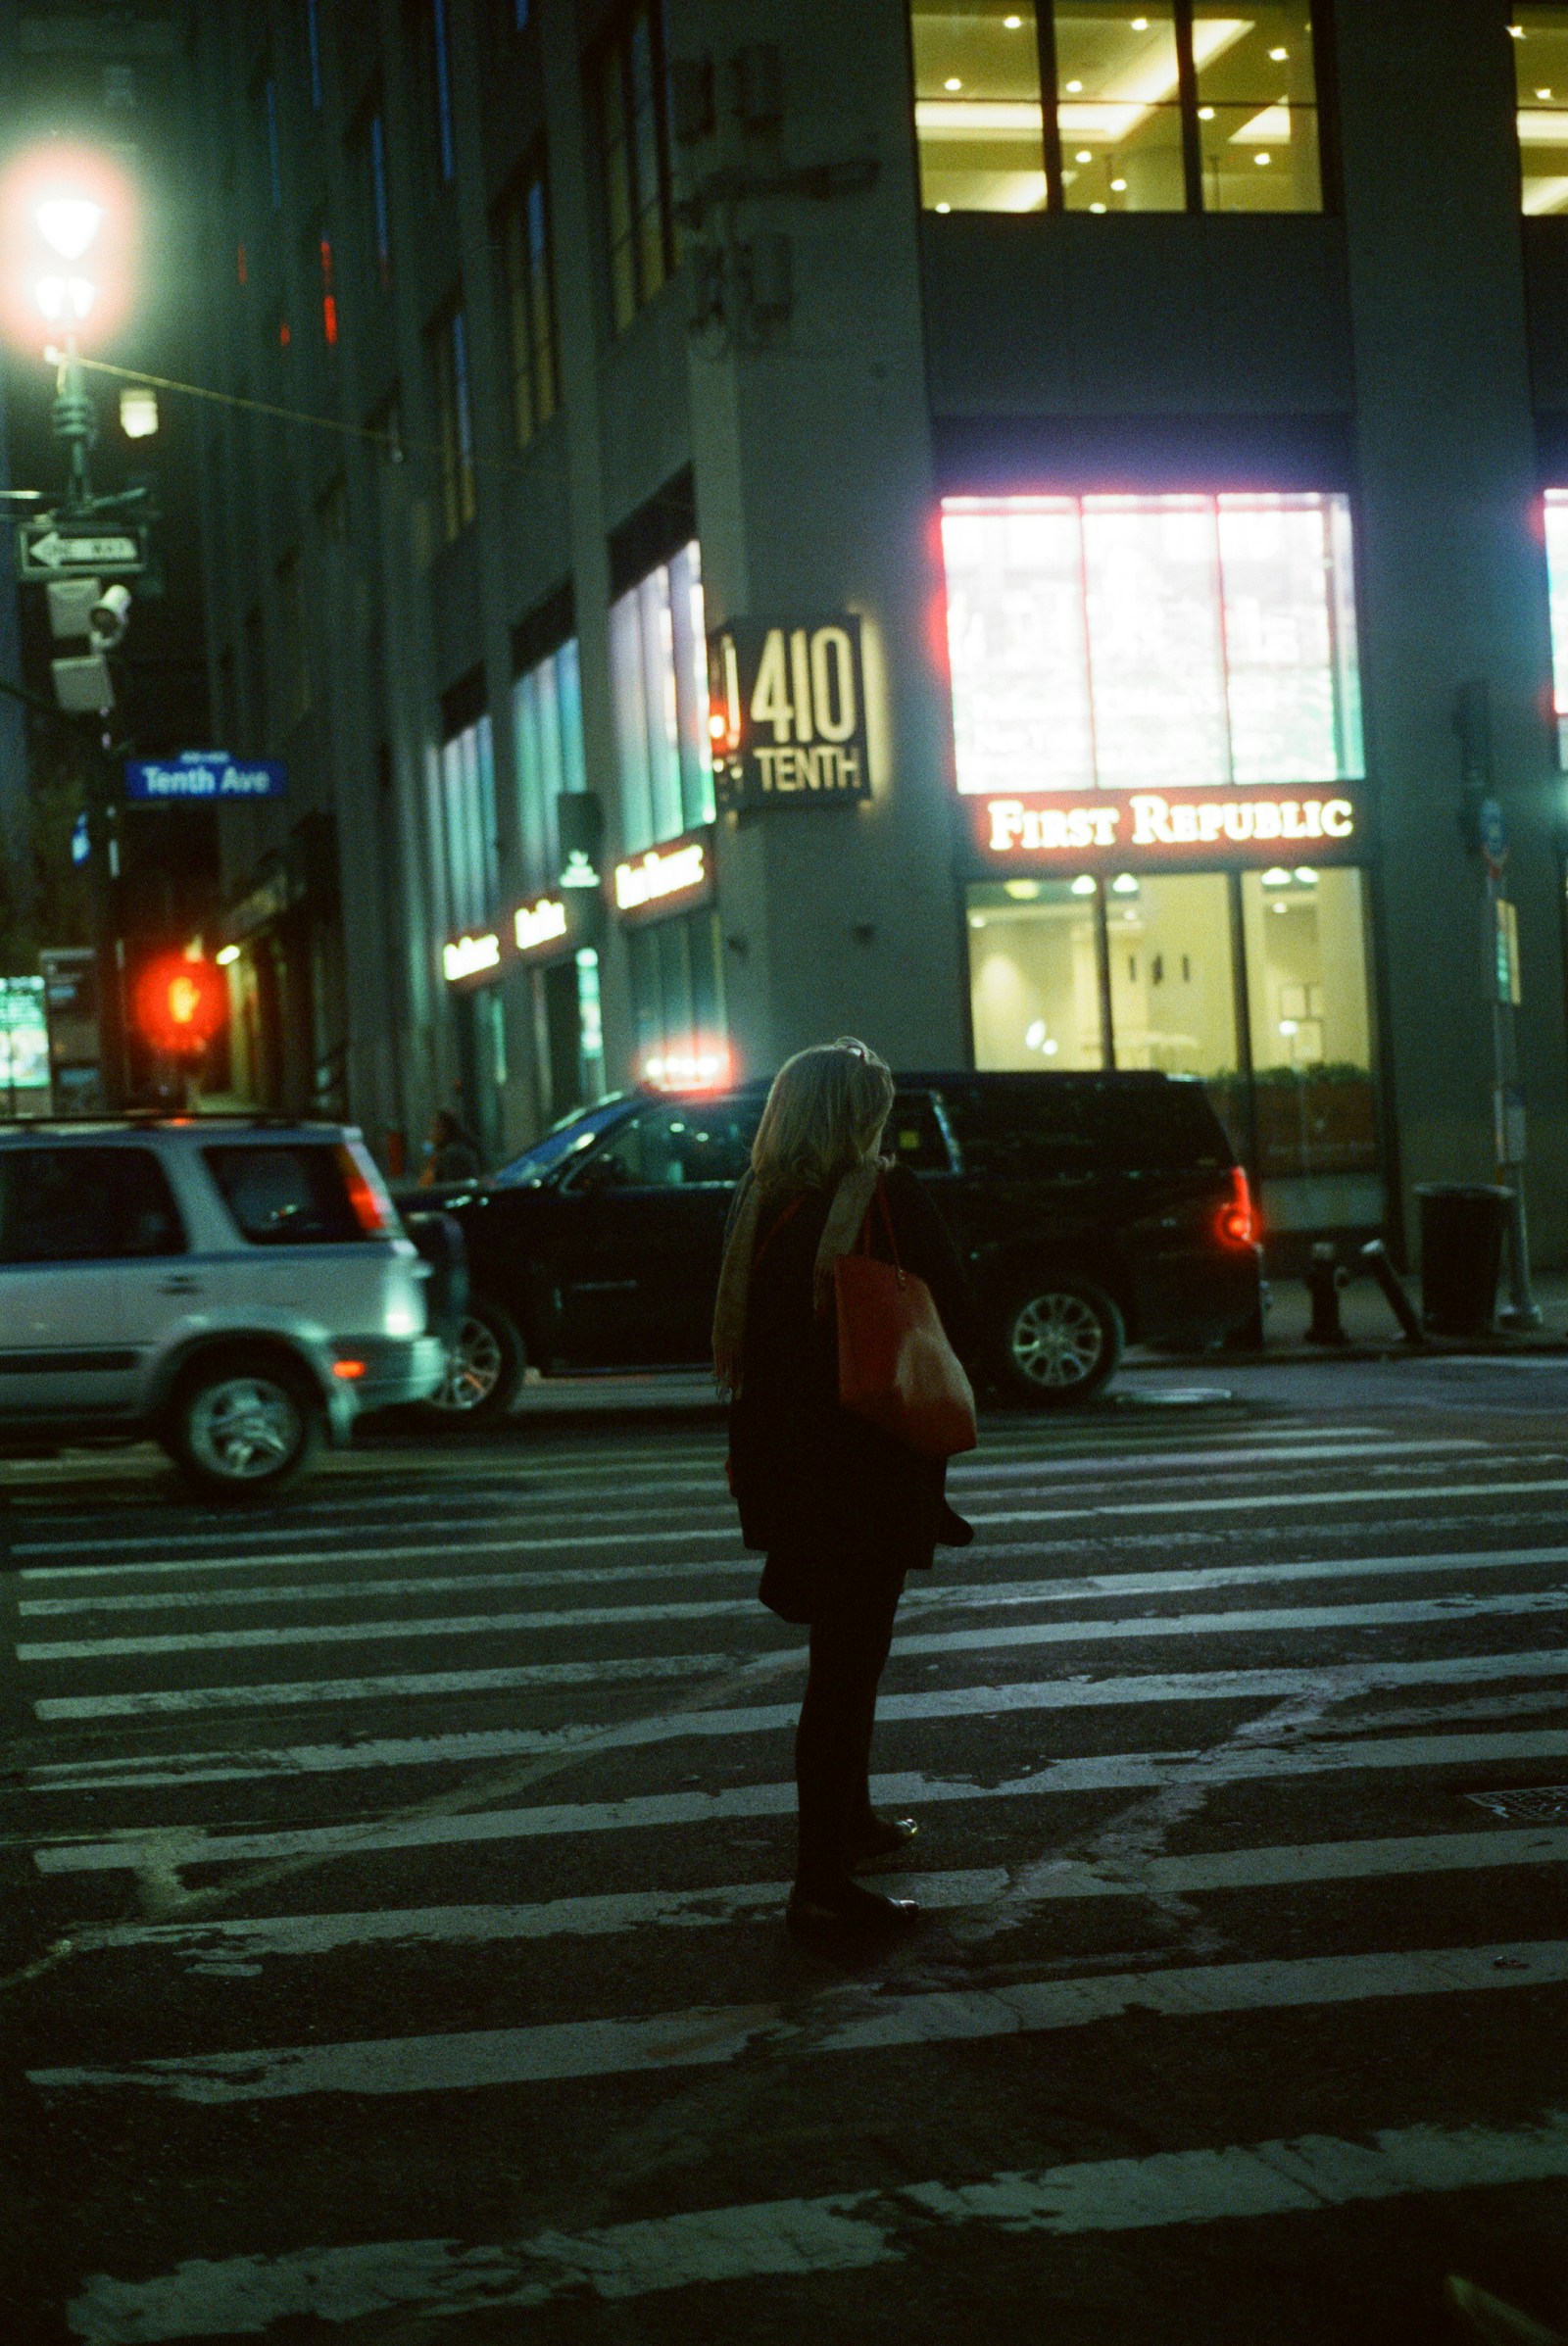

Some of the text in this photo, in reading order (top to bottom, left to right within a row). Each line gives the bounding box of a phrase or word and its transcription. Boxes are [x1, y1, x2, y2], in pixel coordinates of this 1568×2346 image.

[751, 626, 856, 743] 410
[142, 765, 270, 795] Tenth Ave
[752, 746, 860, 791] TENTH
[988, 796, 1353, 851] FIRST REPUBLIC
